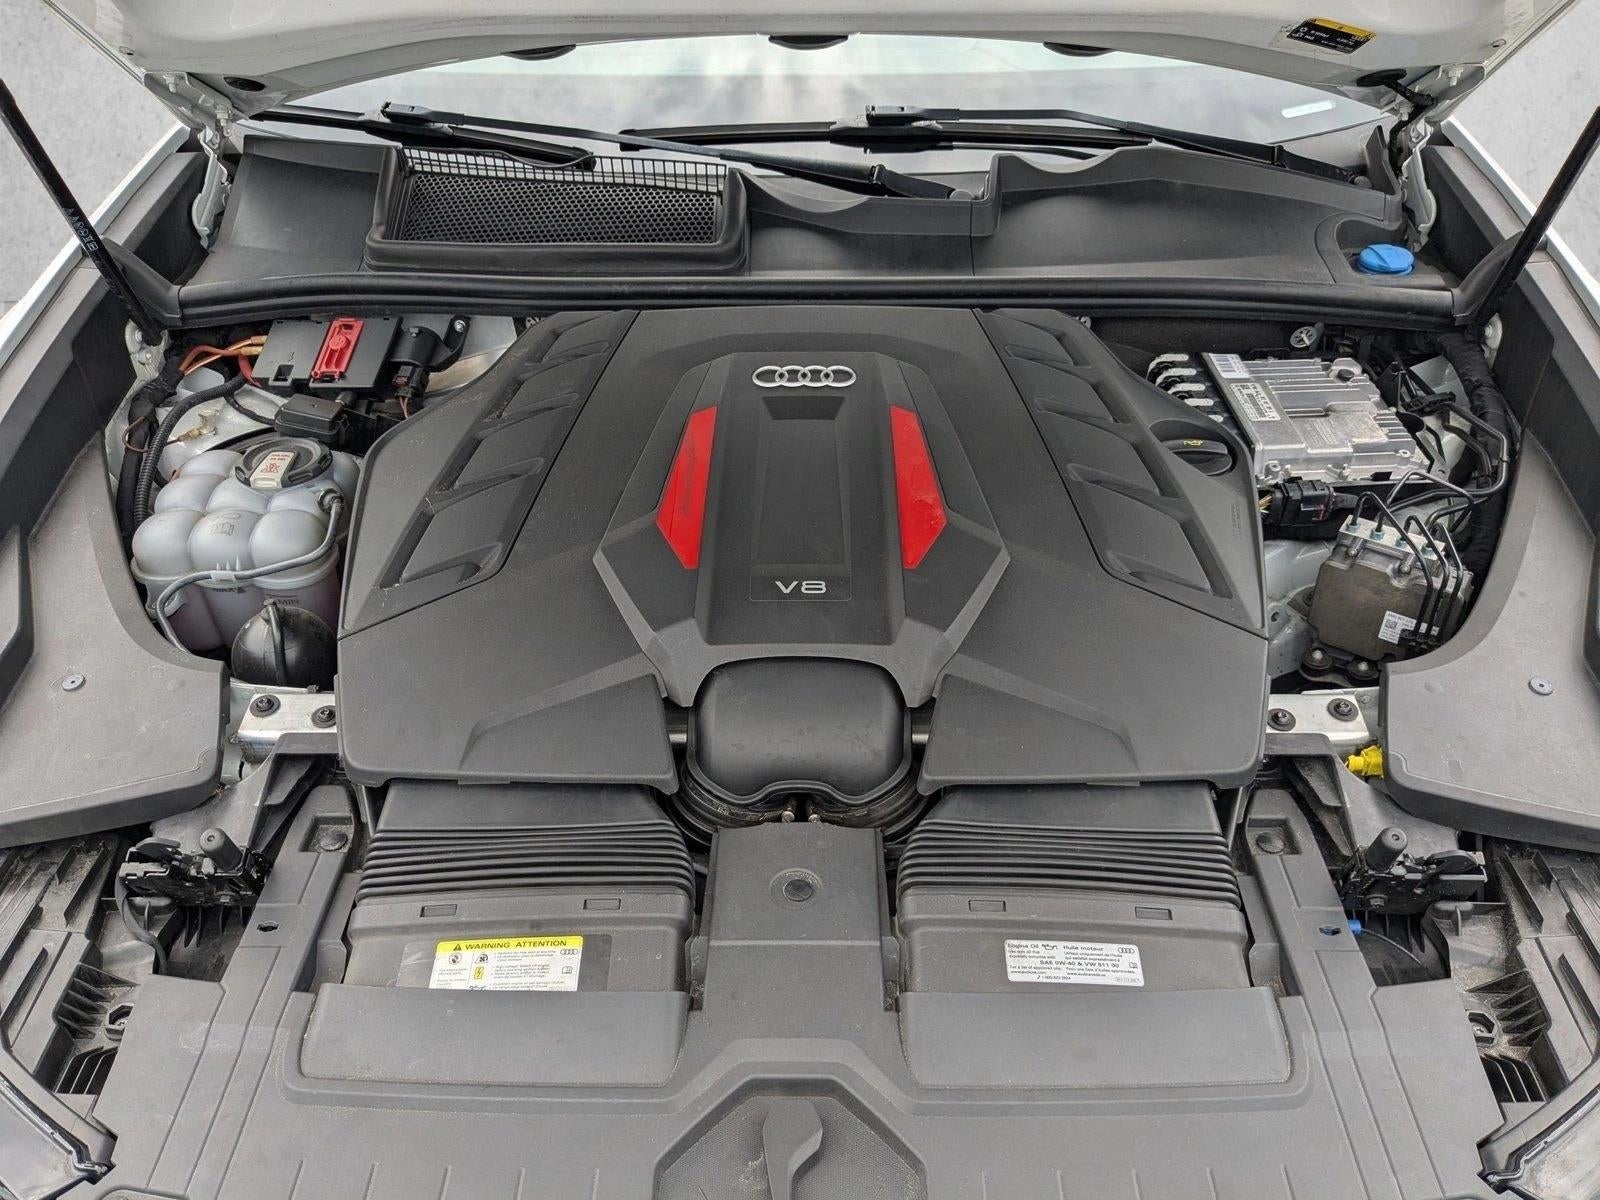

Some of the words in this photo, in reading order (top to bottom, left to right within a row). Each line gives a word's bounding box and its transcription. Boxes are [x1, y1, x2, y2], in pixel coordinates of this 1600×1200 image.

[774, 580, 827, 594] V8
[466, 942, 510, 950] WARNING
[515, 940, 567, 948] ATTENTION
